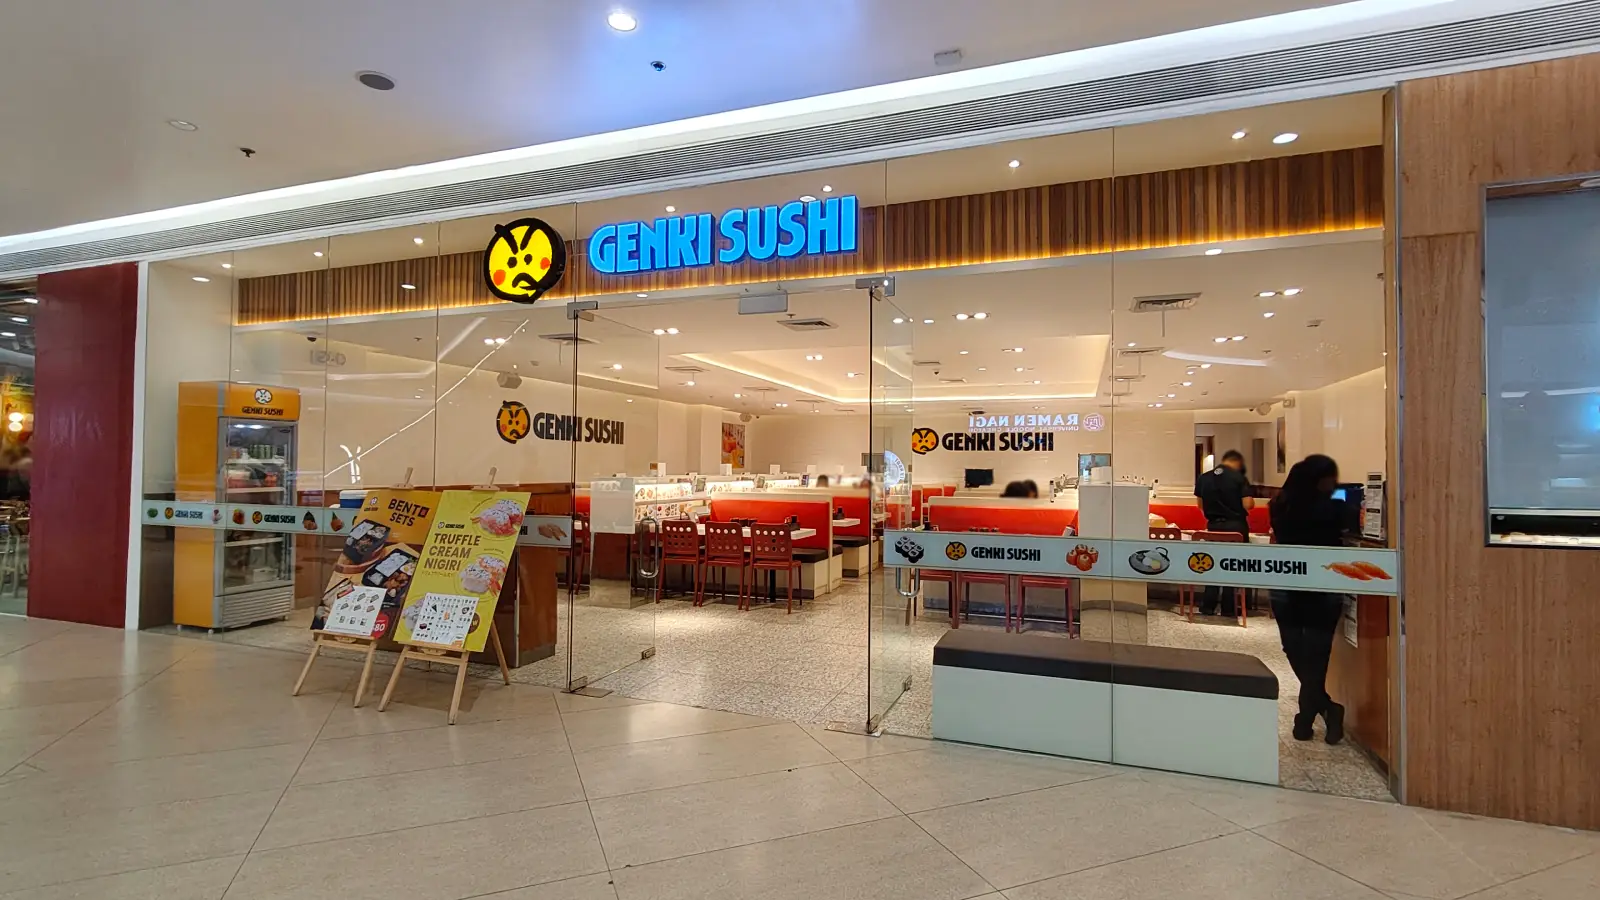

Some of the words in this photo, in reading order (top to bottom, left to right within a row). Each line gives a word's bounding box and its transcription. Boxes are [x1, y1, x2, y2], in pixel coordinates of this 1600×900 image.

[588, 213, 715, 275] GENKI
[718, 195, 859, 265] SUSHI
[533, 412, 583, 442] GENKI
[584, 417, 625, 445] SUSHI
[942, 432, 995, 451] GENKI
[999, 432, 1054, 451] SUSHI
[389, 512, 416, 527] SETS
[434, 532, 482, 546] TRUFFLE
[429, 545, 472, 559] CREAM
[971, 546, 1005, 560] GENKI
[1007, 549, 1041, 562] SUSHI
[424, 558, 462, 571] NIGIRI
[1220, 558, 1262, 573] GENKI
[1264, 560, 1307, 575] SUSHI
